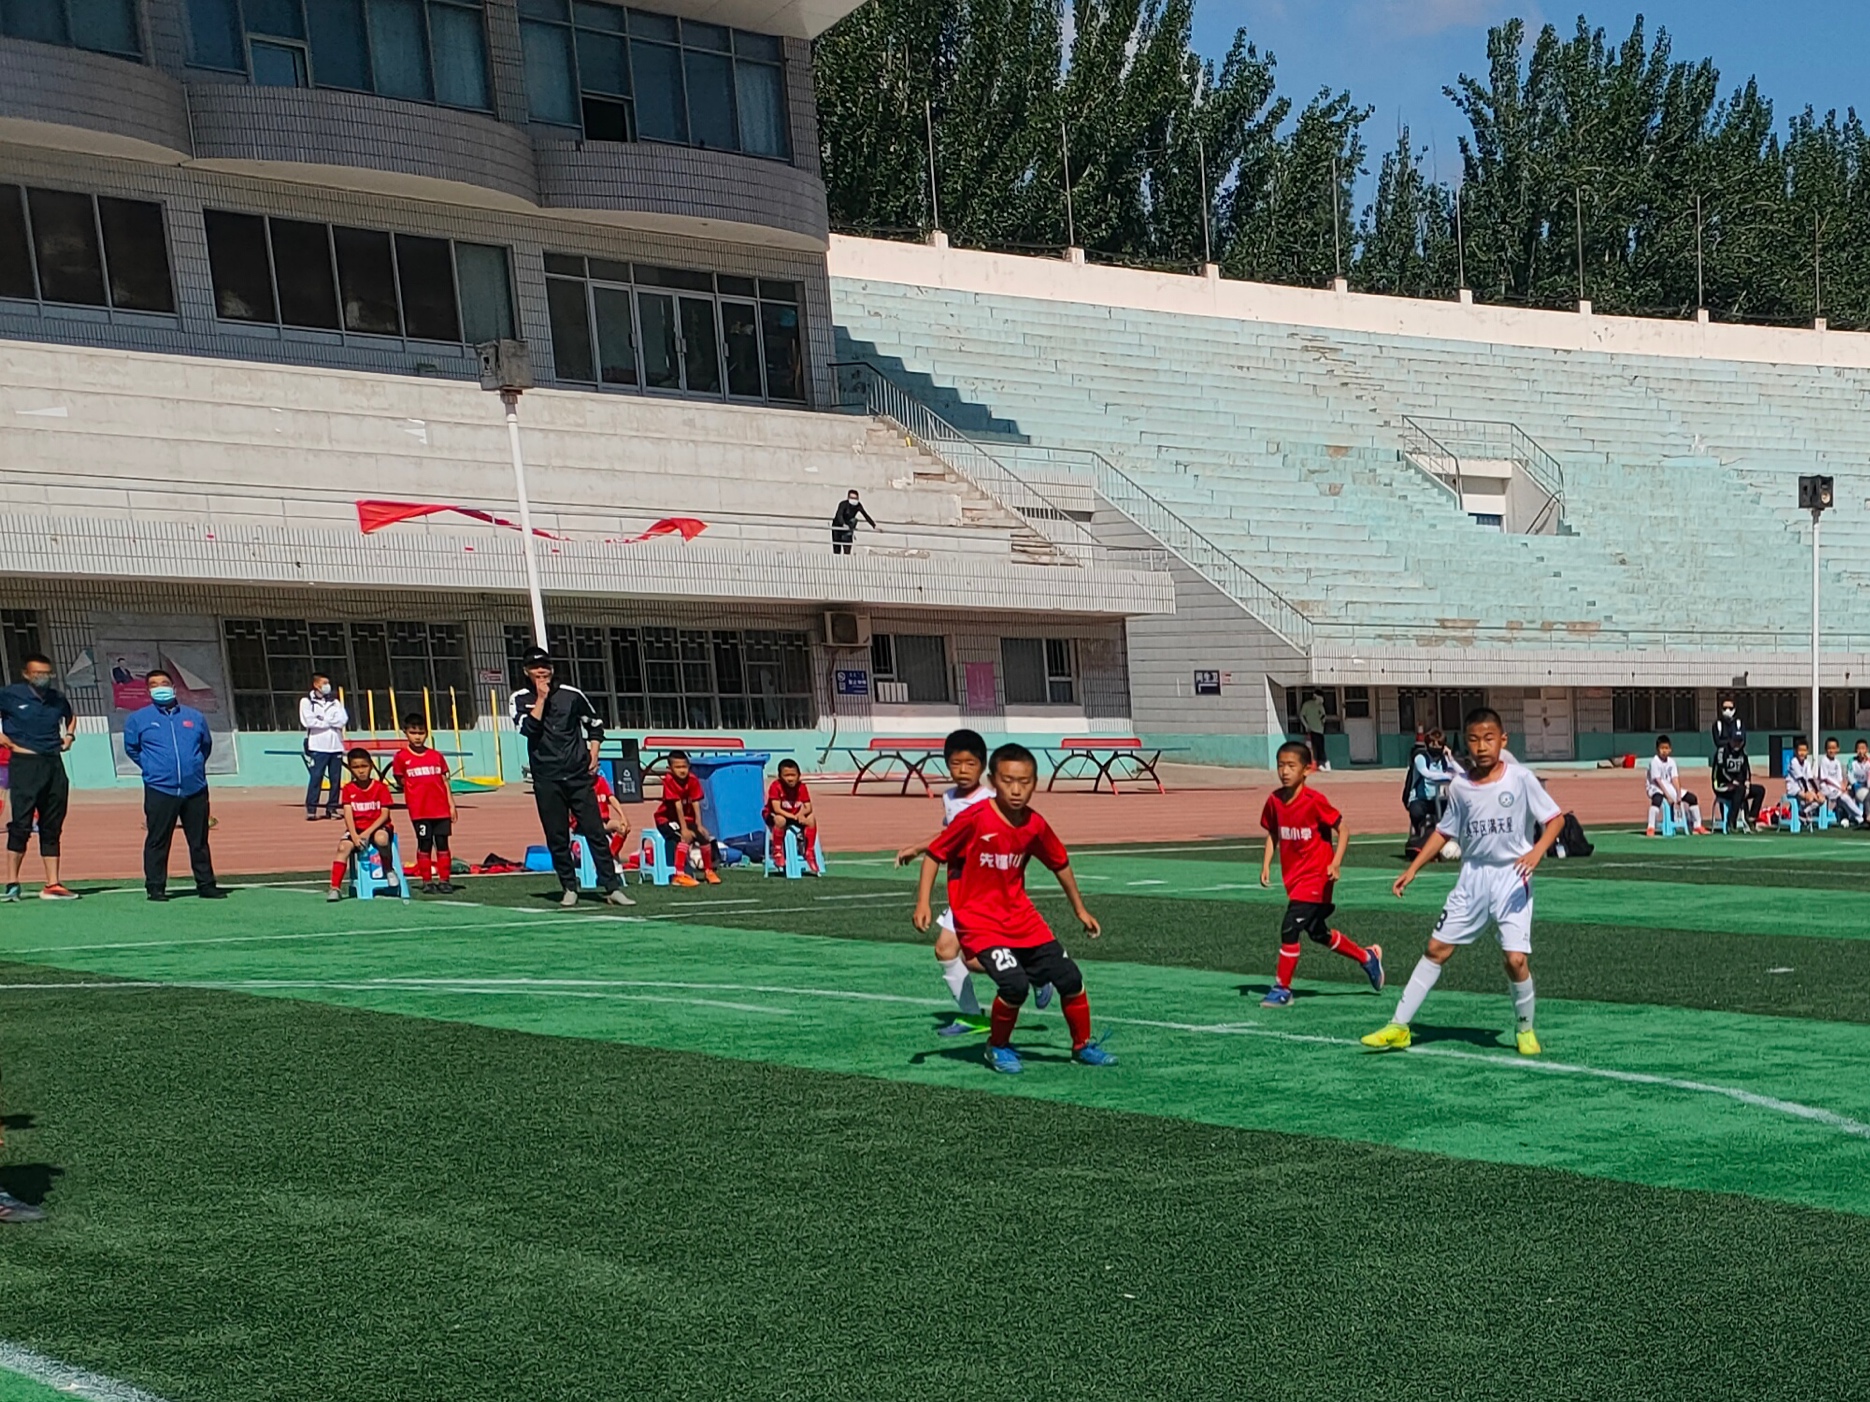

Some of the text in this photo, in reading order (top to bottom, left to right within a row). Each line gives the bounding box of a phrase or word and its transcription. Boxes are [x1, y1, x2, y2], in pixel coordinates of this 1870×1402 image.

[419, 824, 427, 836] 3
[1435, 909, 1448, 931] 8
[991, 947, 1018, 971] 25
